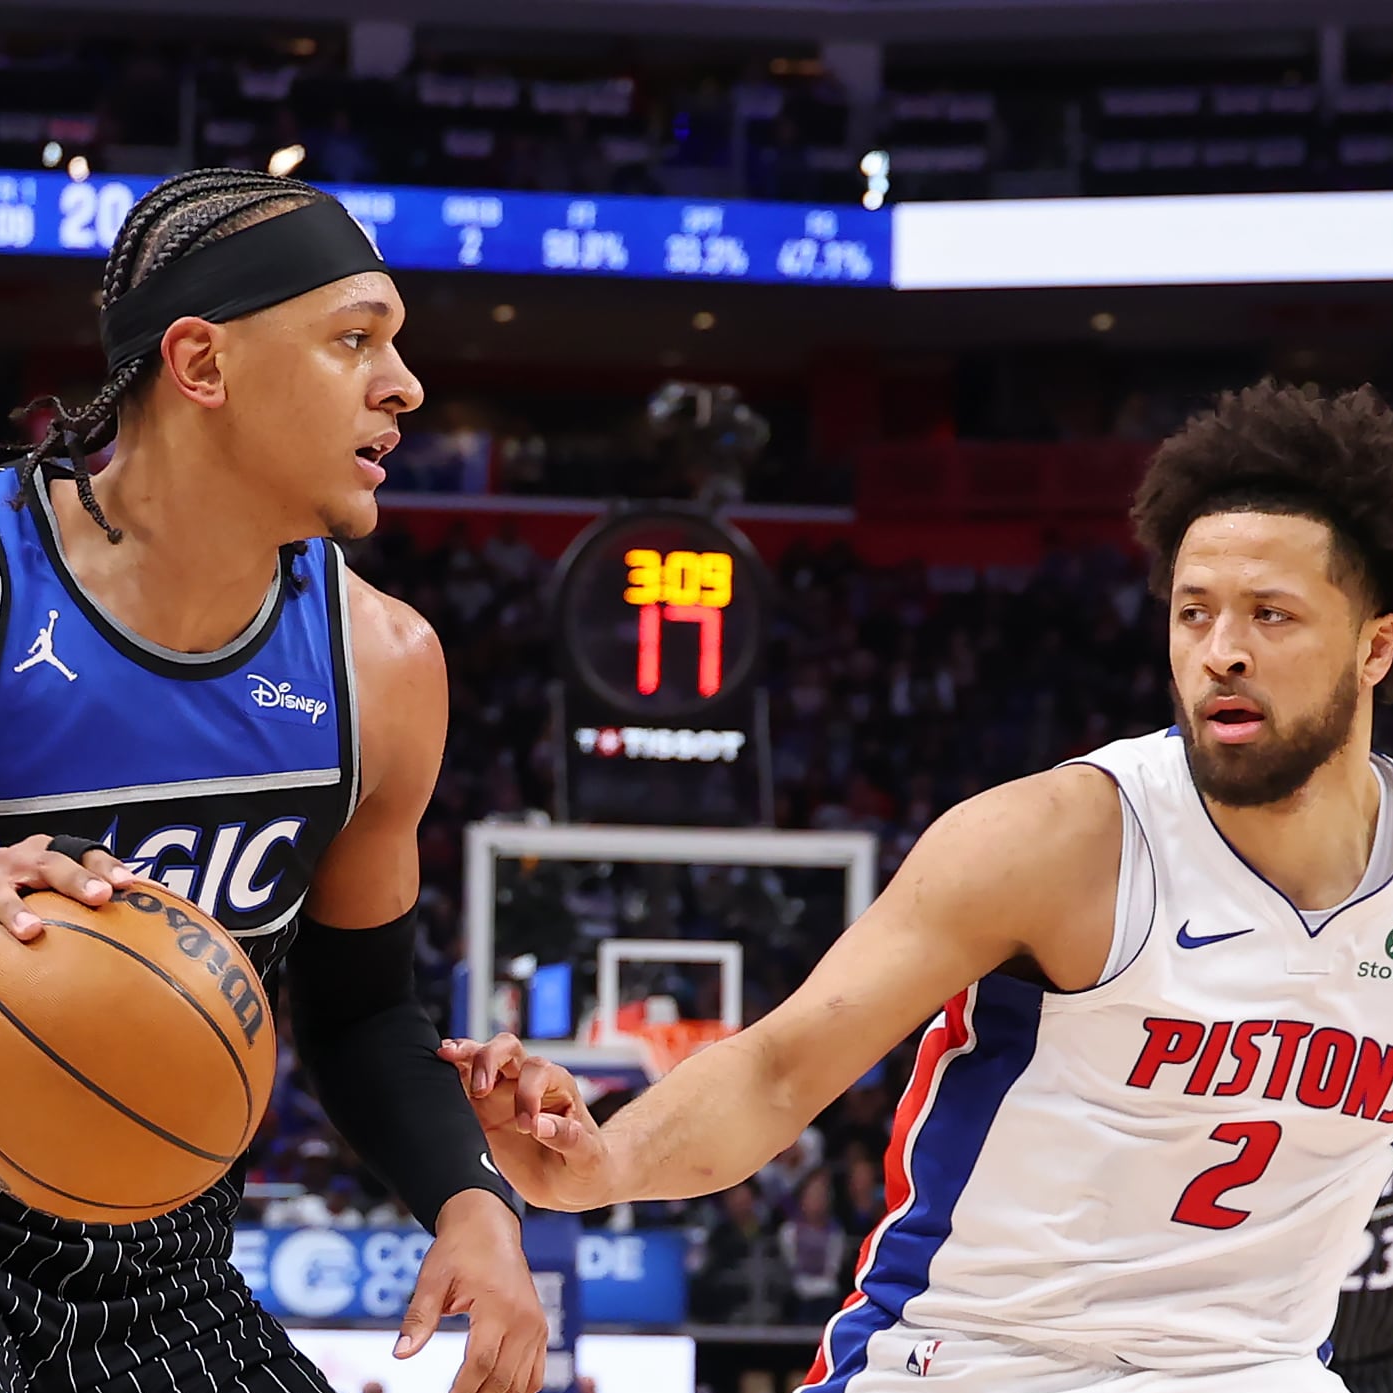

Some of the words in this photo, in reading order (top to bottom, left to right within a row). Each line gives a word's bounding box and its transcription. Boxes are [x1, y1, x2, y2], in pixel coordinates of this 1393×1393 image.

[58, 181, 134, 249] 20
[637, 604, 723, 698] 17
[1170, 1119, 1283, 1231] 2
